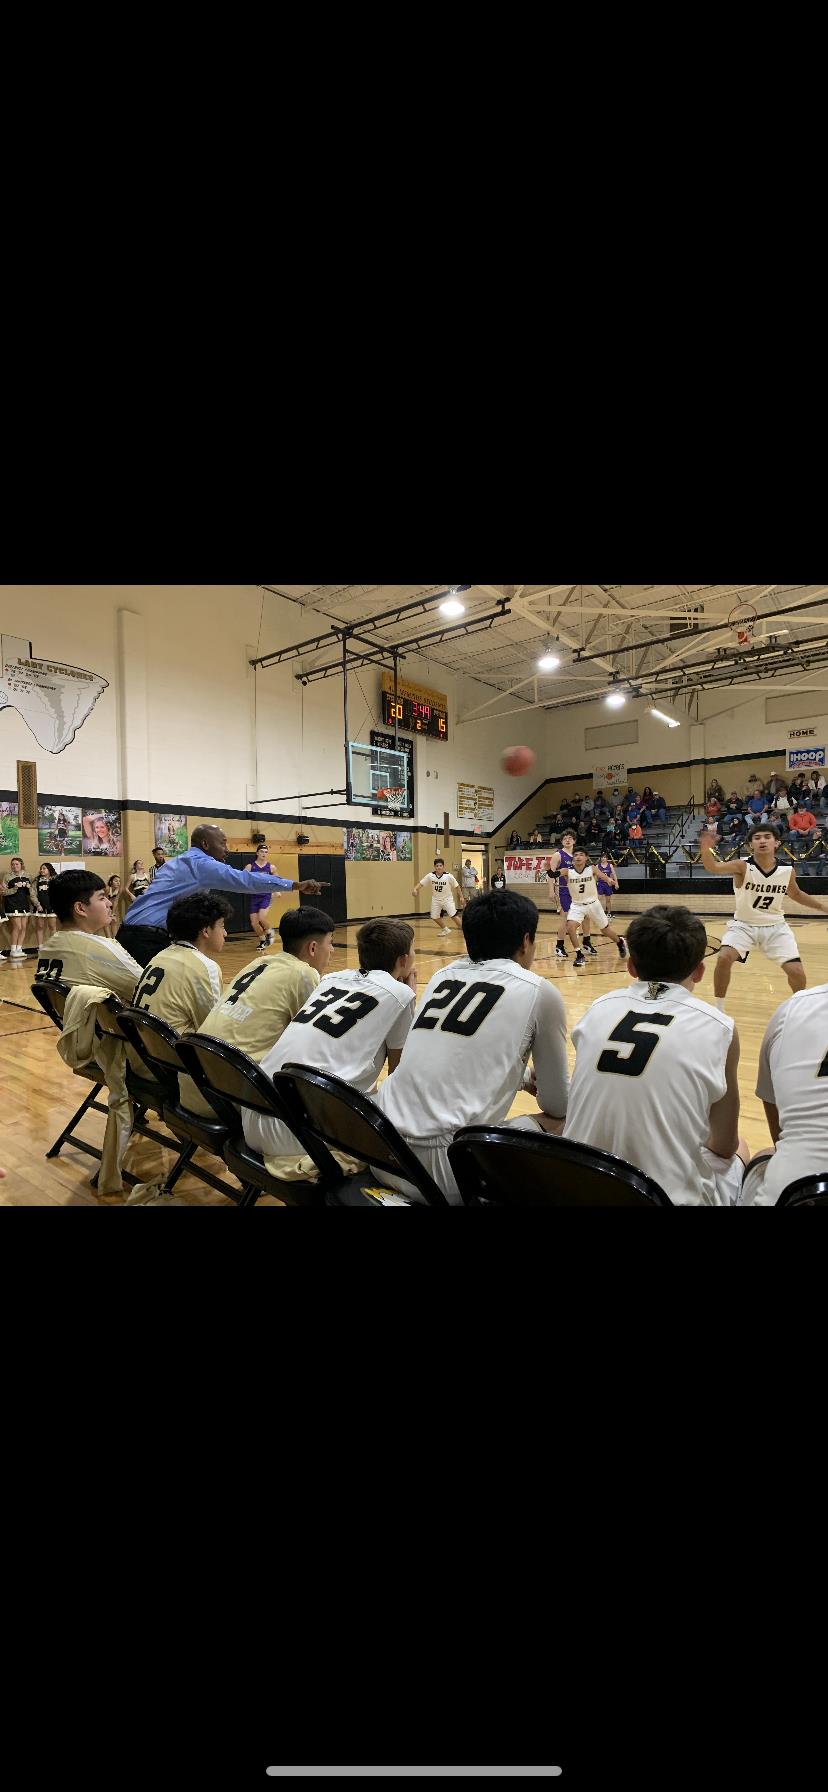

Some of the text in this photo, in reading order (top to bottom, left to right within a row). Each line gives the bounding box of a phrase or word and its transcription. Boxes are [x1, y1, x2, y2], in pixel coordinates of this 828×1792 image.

[17, 658, 43, 670] LADY
[46, 664, 94, 682] CYCLONES
[391, 702, 403, 719] 20
[412, 701, 430, 720] 3:49
[416, 720, 422, 730] 2
[438, 718, 446, 732] 15
[789, 730, 815, 738] HOME
[790, 751, 824, 763] IHOOP
[578, 884, 585, 893] 3
[745, 881, 787, 894] CYCLONES
[752, 896, 775, 910] 13
[225, 963, 268, 1006] 4
[292, 986, 380, 1039] 33
[412, 979, 506, 1037] 20
[596, 1009, 675, 1077] 5
